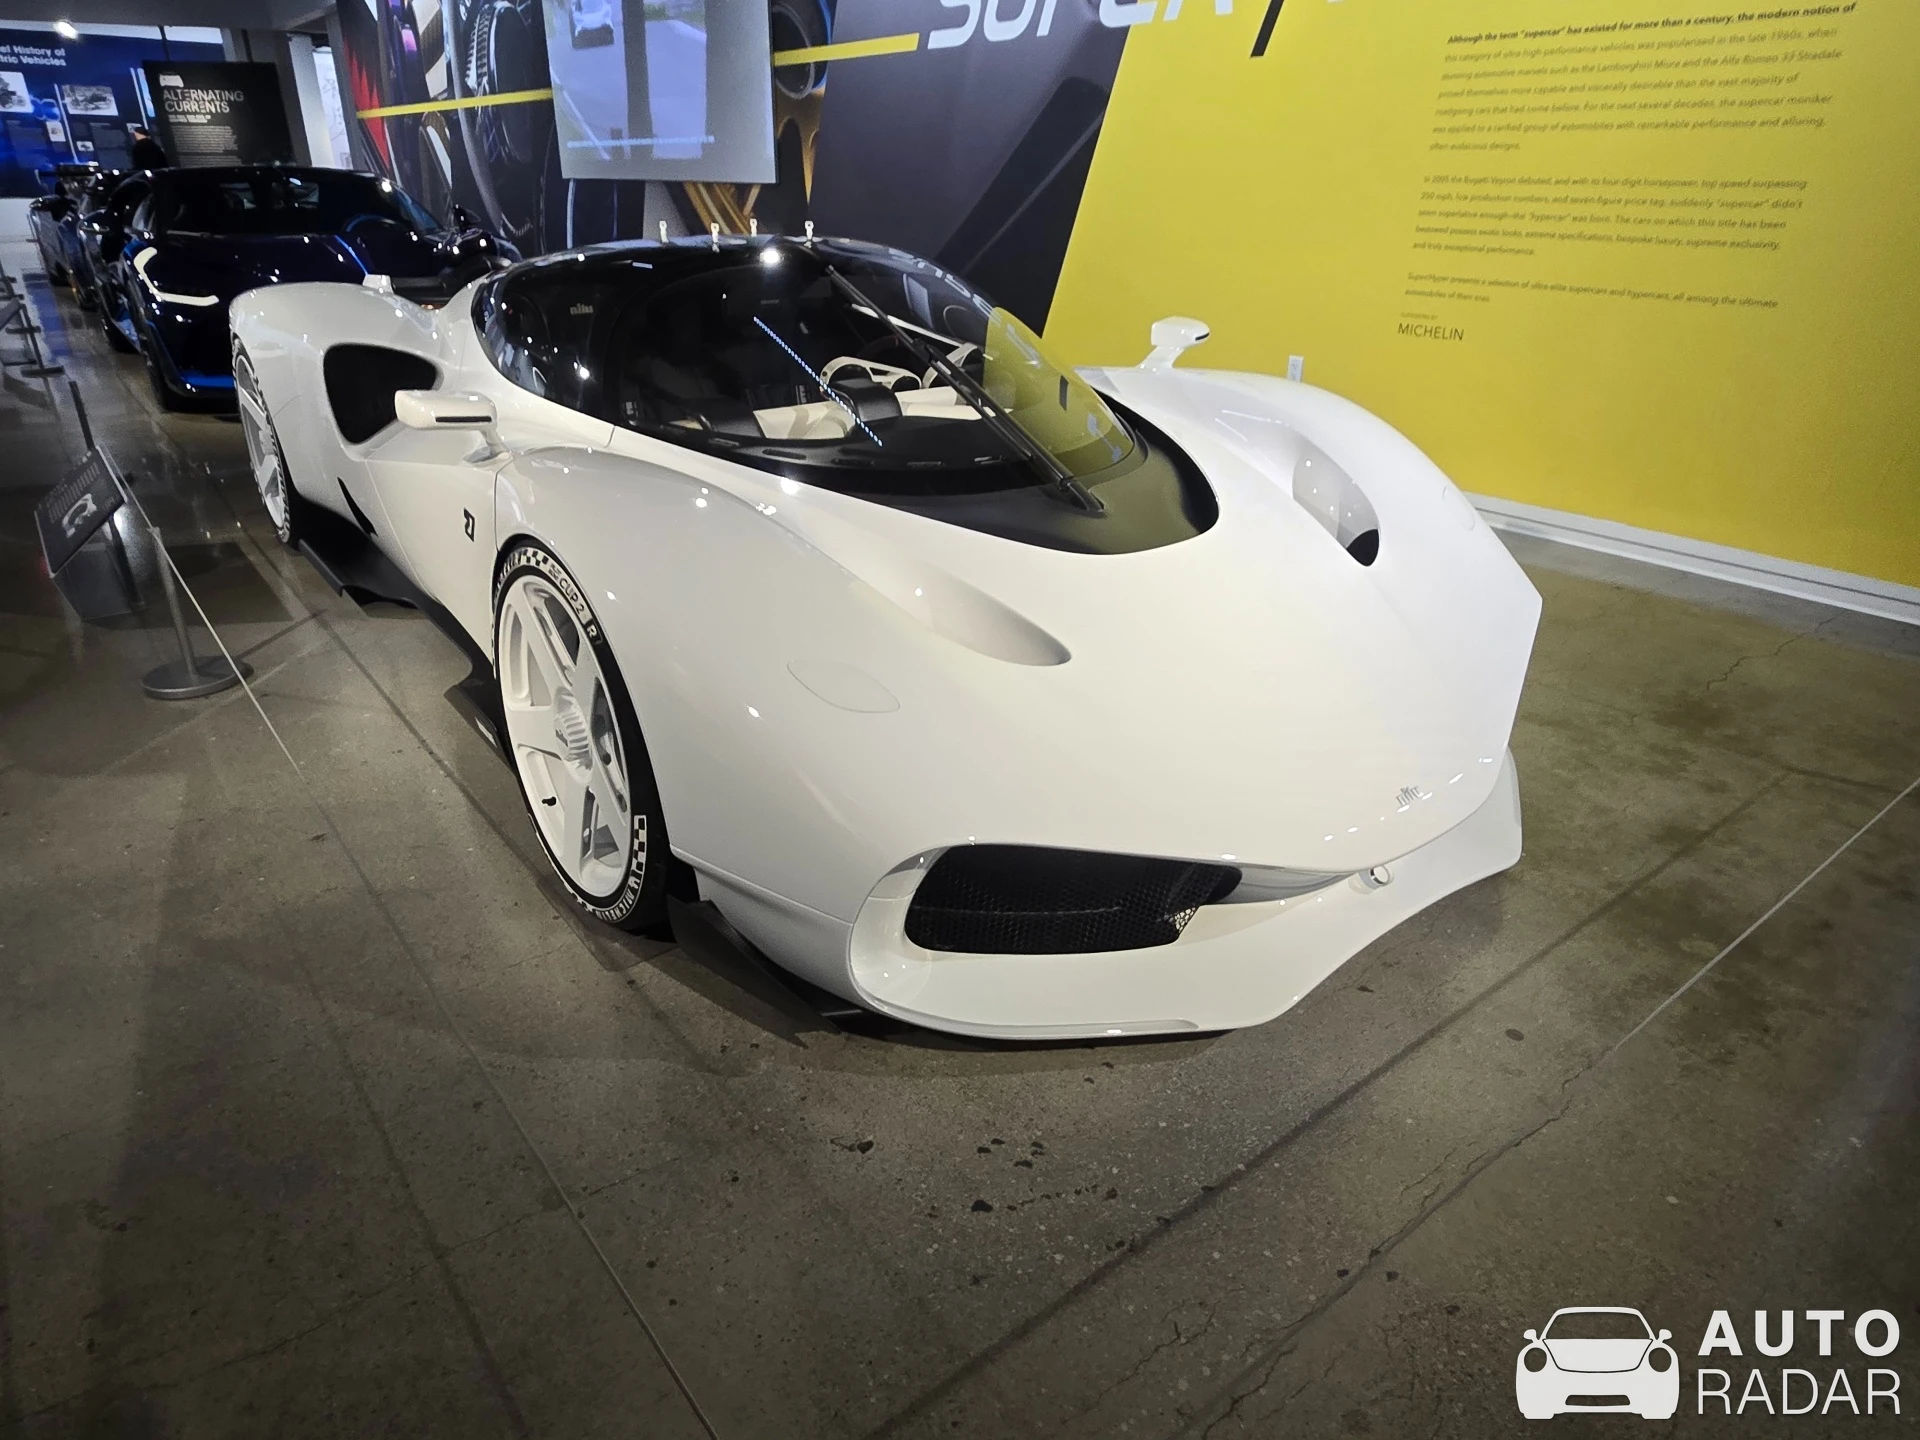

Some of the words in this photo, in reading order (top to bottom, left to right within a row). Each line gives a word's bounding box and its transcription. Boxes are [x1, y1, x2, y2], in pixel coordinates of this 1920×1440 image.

[1618, 21, 1632, 30] for
[1633, 21, 1660, 29] more
[1661, 18, 1683, 27] than
[1738, 12, 1754, 21] the
[1757, 8, 1800, 18] modern
[1802, 5, 1840, 14] notion
[1842, 3, 1856, 12] of
[13, 45, 51, 57] History
[54, 48, 66, 56] of
[20, 55, 67, 66] Vehicles
[163, 89, 244, 102] ALTERNATING
[165, 101, 230, 113] CURRENTS
[1397, 322, 1465, 342] MICHELIN
[560, 578, 579, 602] CUP
[576, 603, 585, 615] 2
[586, 624, 598, 638] R
